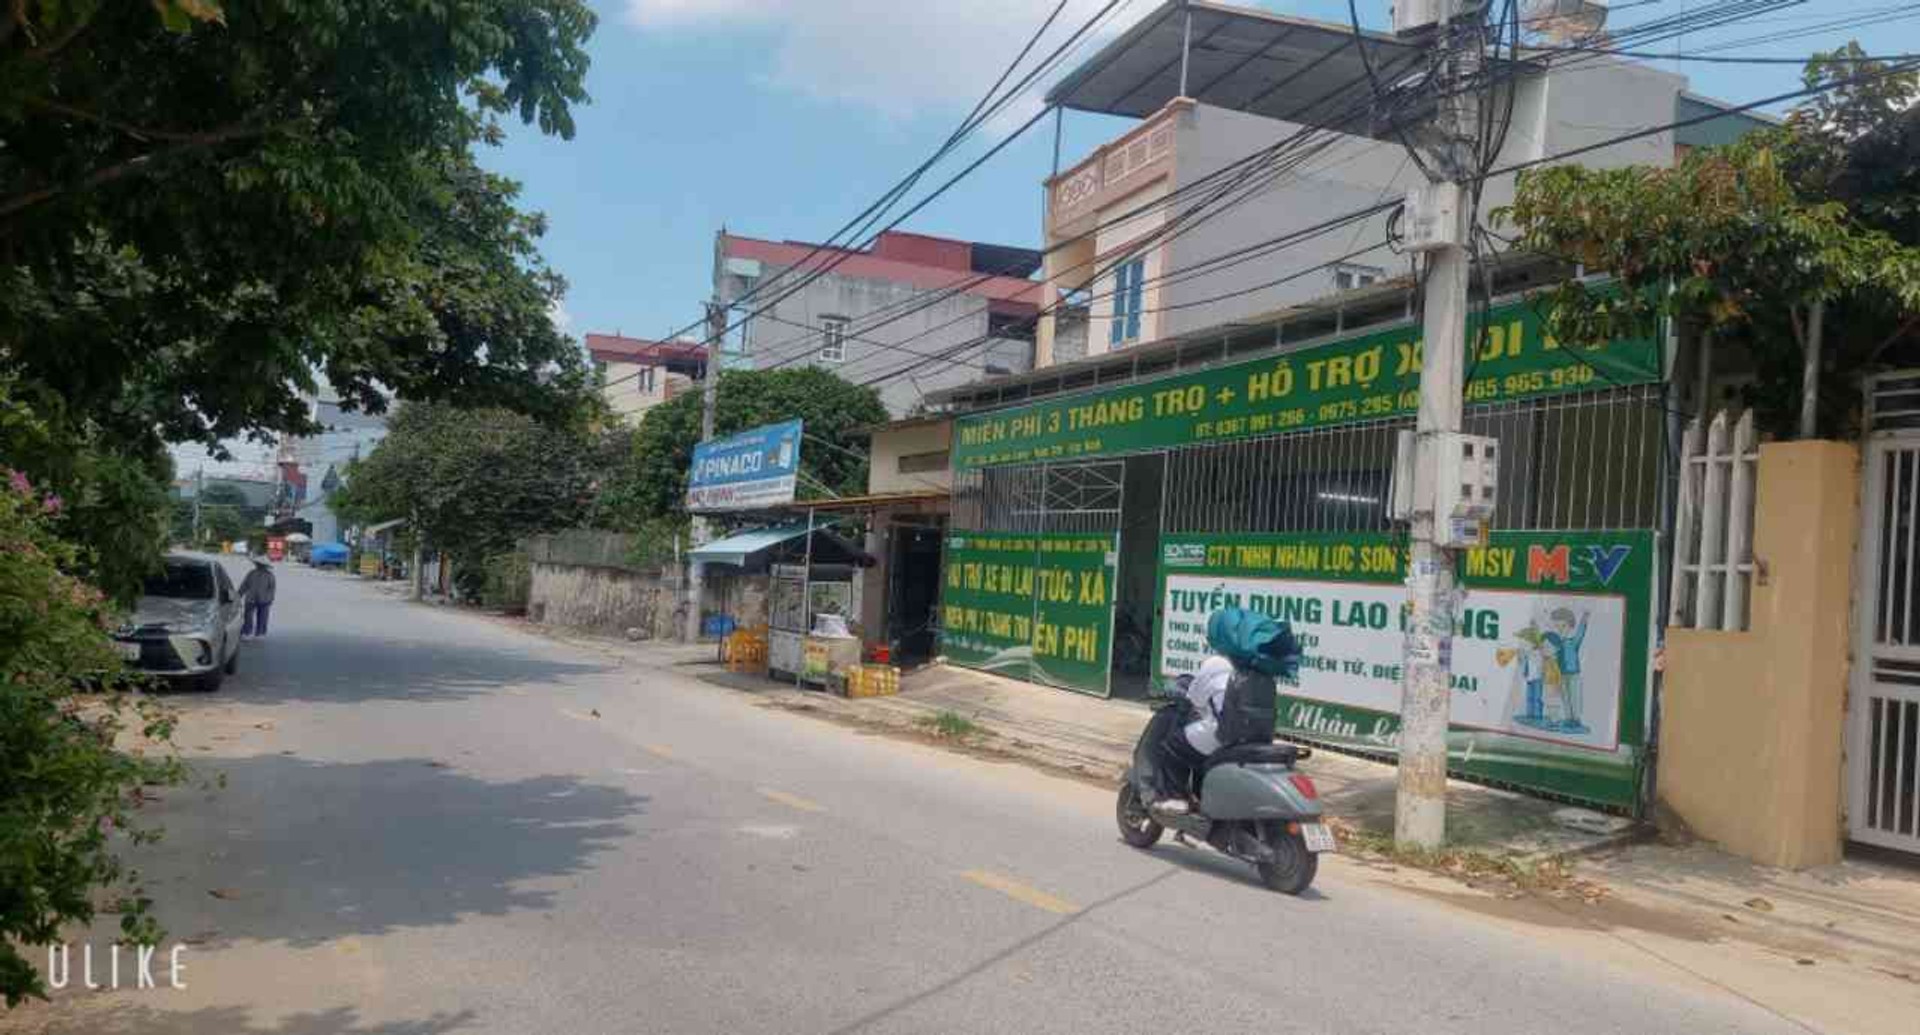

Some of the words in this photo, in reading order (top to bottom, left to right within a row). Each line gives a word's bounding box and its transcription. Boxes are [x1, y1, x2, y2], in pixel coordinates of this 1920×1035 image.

[1049, 410, 1060, 432] 3
[1068, 396, 1144, 432] THÁNG
[1152, 385, 1205, 417] TRỌ
[1215, 387, 1236, 405] +
[1248, 358, 1294, 401] HỖ
[1306, 346, 1383, 391] TRỢ
[1505, 372, 1544, 395] 965
[1552, 363, 1594, 387] 930
[706, 451, 763, 478] PINACO
[1323, 546, 1355, 577] LỰC
[1466, 546, 1516, 577] MSV
[1527, 544, 1632, 586] MSV
[1332, 599, 1388, 631] LAO
[1064, 622, 1098, 662] PHÍ
